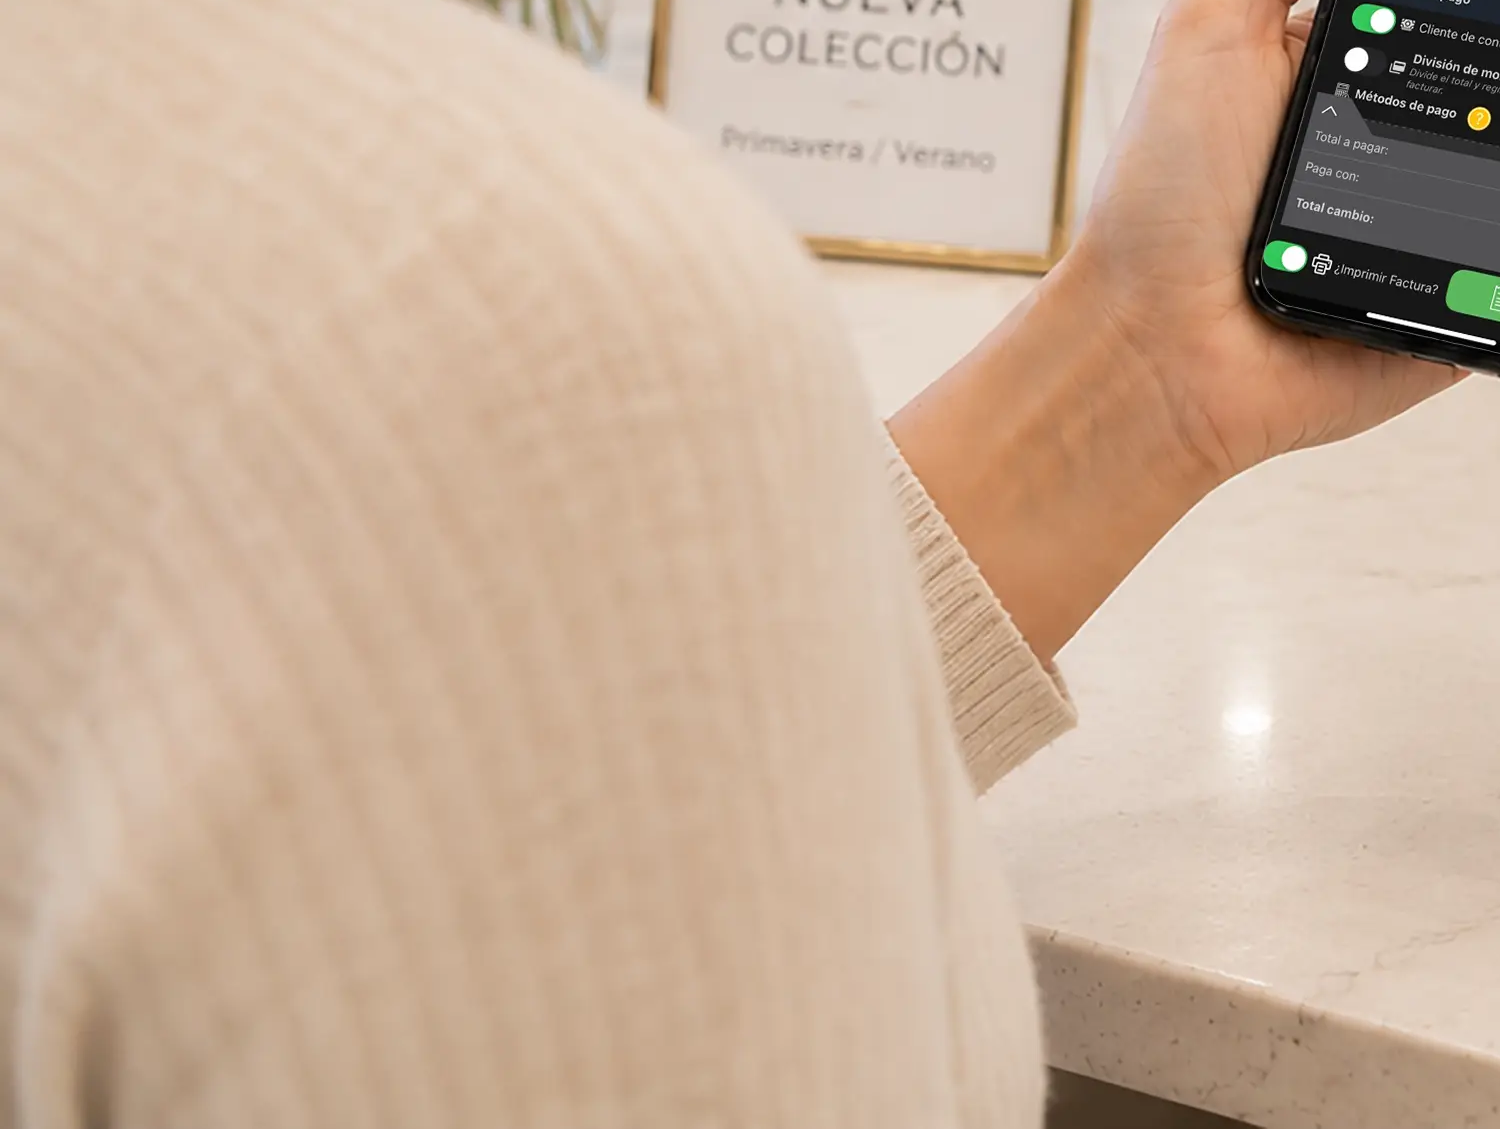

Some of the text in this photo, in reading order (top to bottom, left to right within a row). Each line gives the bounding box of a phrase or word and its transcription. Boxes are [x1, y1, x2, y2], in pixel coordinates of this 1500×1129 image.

[1419, 22, 1457, 40] Cliente
[1460, 31, 1476, 43] de
[725, 23, 1006, 78] COLECCIÓN
[1409, 68, 1438, 81] Divide
[1440, 75, 1449, 83] el
[1451, 77, 1472, 88] total
[1413, 53, 1460, 72] División
[1462, 65, 1478, 76] de
[1406, 80, 1444, 95] facturar.
[1354, 88, 1457, 120] Métodos de pago
[720, 125, 864, 161] Primavera
[893, 141, 996, 173] Verano
[1315, 130, 1389, 157] Total a pagar:
[1305, 162, 1359, 183] Paga con:
[1296, 198, 1374, 225] Total cambio:
[1334, 264, 1438, 295] ¿Imprimir Factura?
